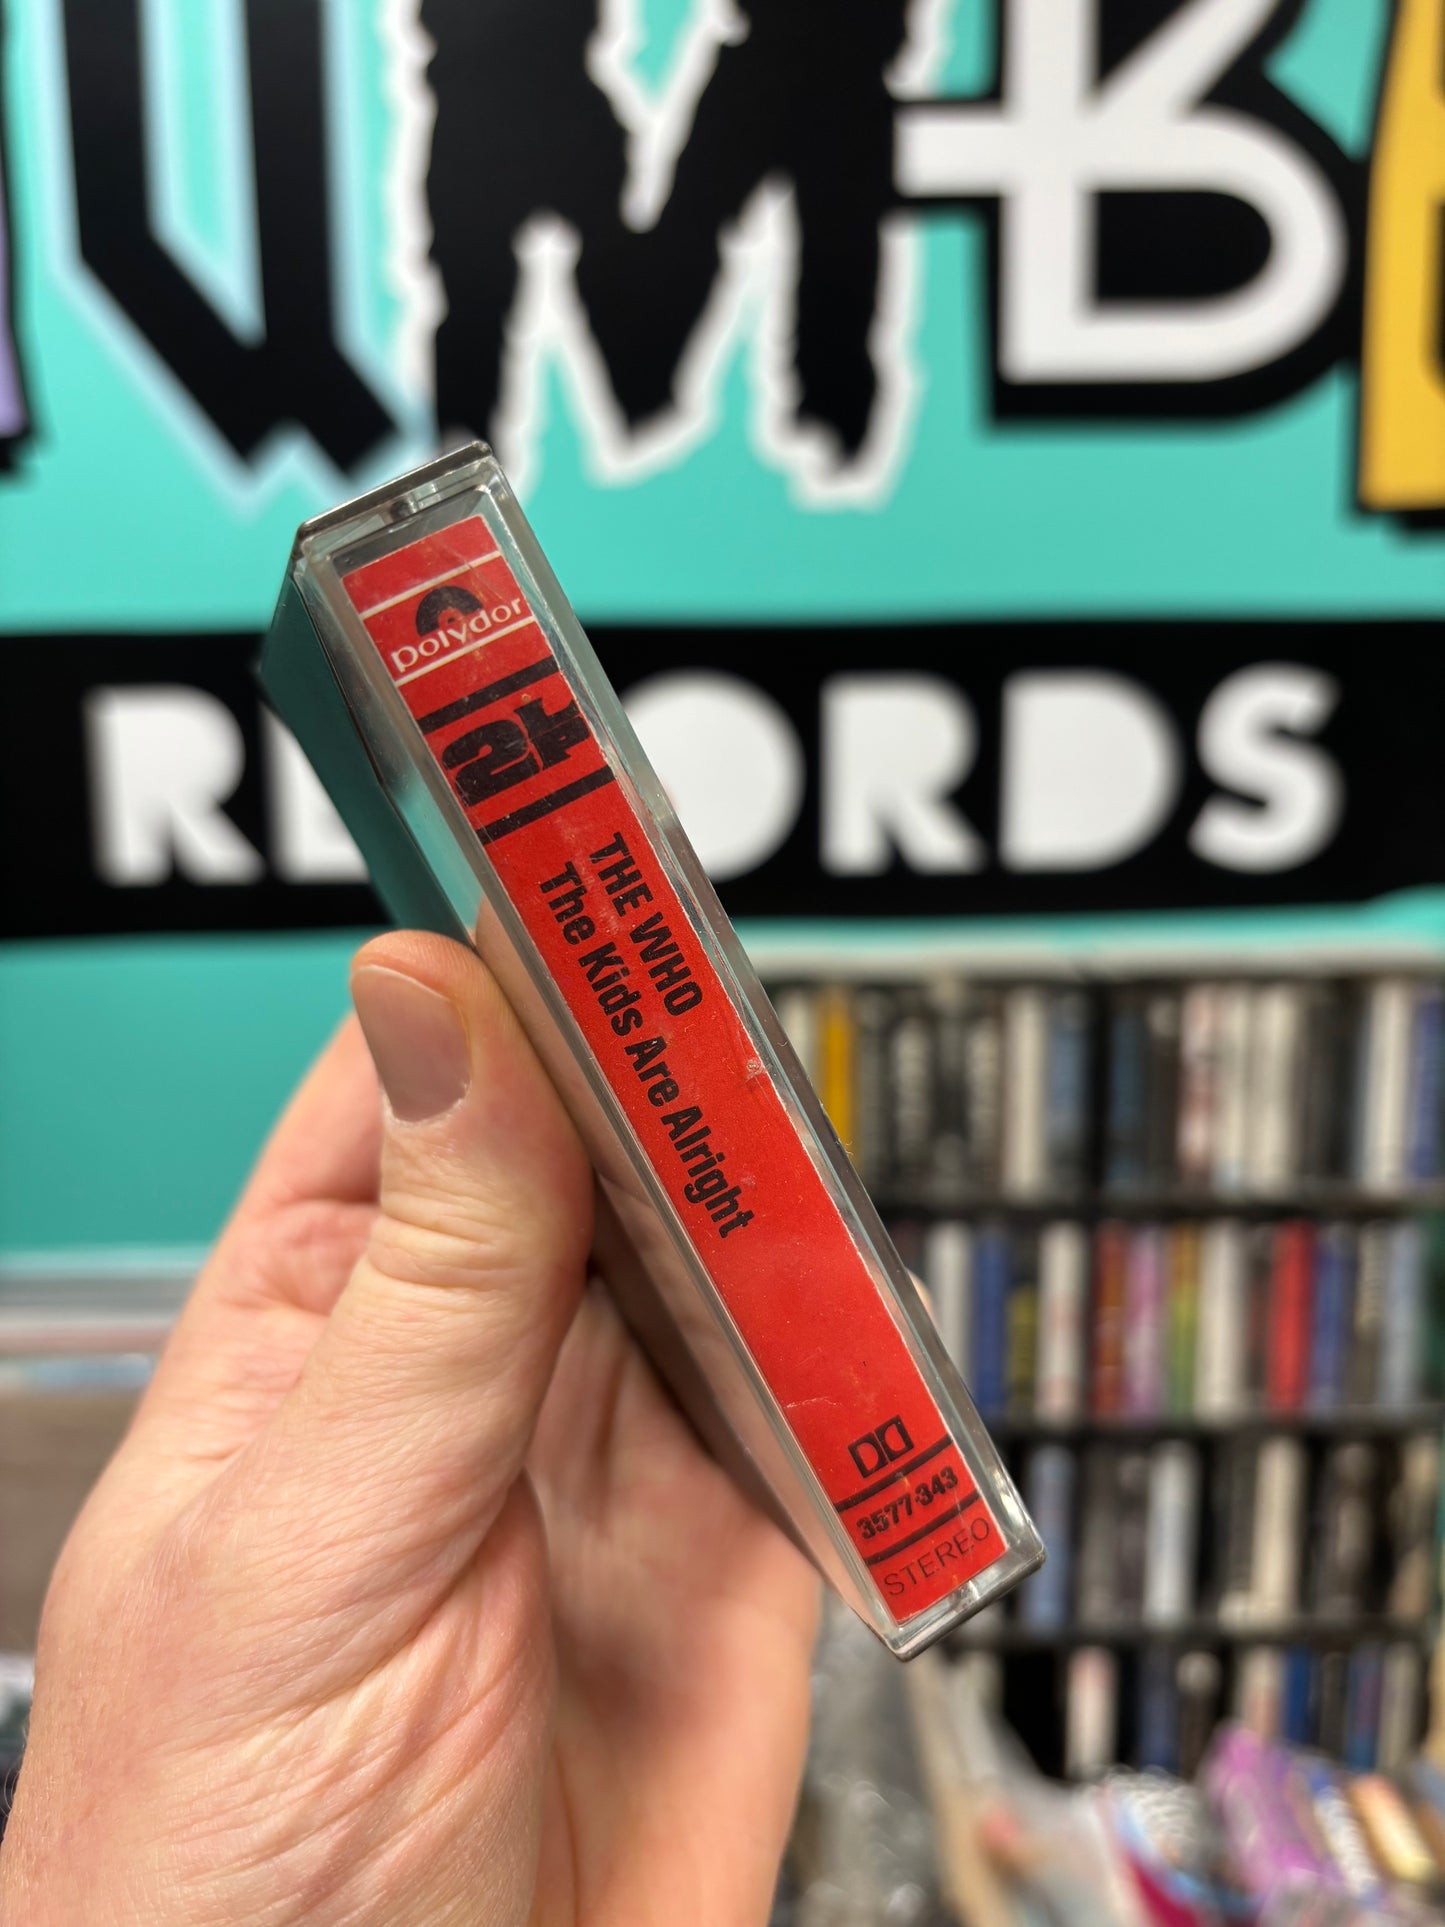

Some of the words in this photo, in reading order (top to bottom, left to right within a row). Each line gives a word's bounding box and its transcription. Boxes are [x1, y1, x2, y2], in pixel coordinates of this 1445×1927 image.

[589, 832, 653, 917] THE
[629, 912, 703, 1017] WHO
[540, 861, 596, 945] The
[577, 941, 643, 1037] Kids
[624, 1035, 680, 1107] Are
[660, 1106, 755, 1239] Alright
[884, 1517, 991, 1596] STEREO
